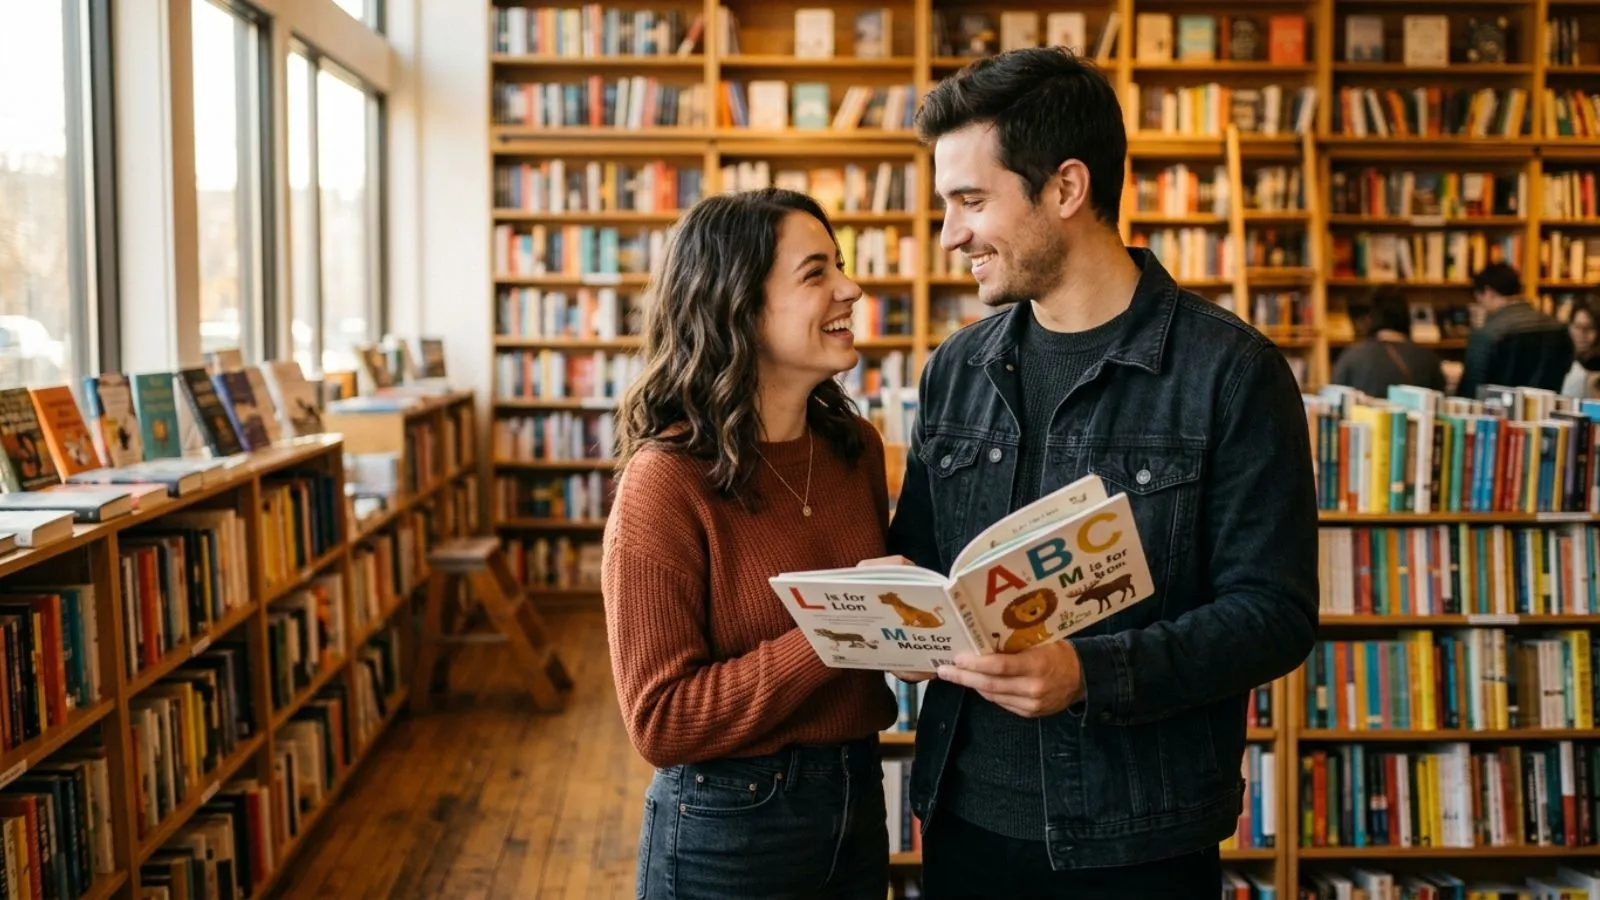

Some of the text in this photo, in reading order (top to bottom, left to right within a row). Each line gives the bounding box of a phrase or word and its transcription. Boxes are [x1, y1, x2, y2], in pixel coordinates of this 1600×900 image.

[1058, 566, 1084, 588] M
[1106, 549, 1127, 563] for
[789, 587, 826, 610] L
[843, 592, 866, 602] for
[832, 602, 867, 611] Lion
[880, 627, 908, 641] M
[930, 634, 952, 643] for
